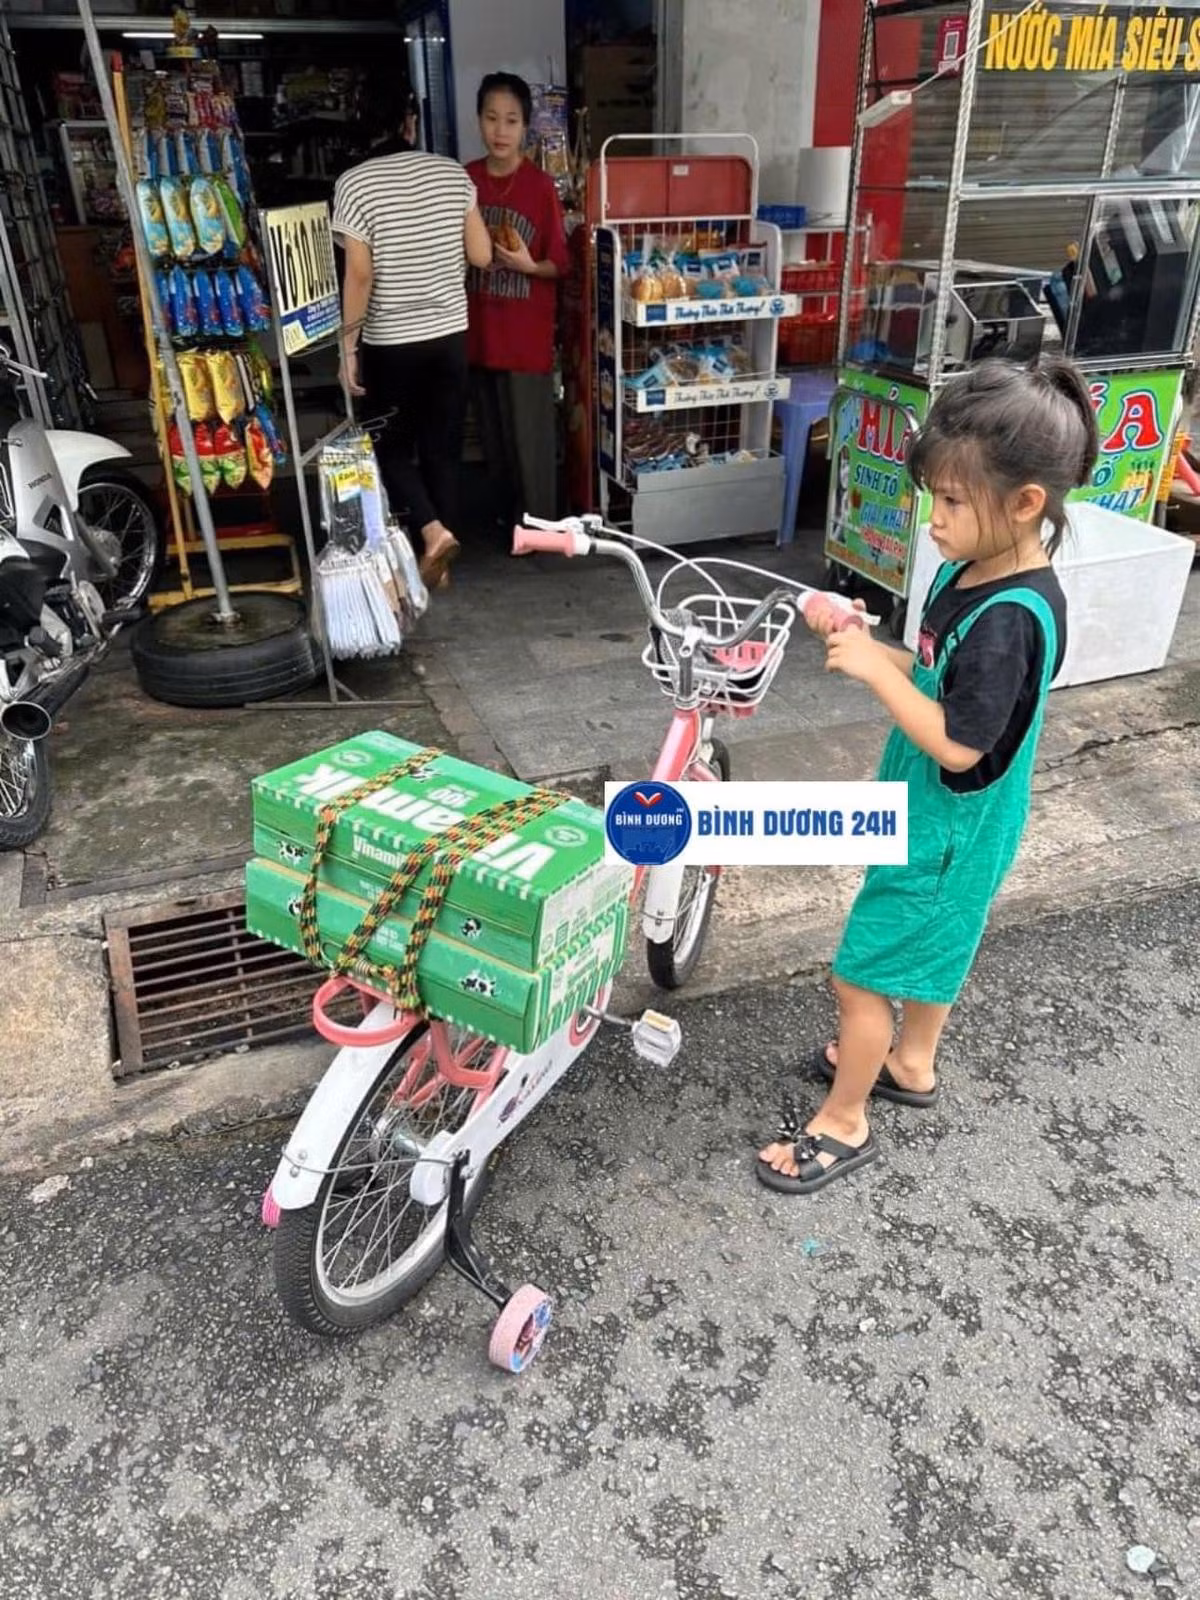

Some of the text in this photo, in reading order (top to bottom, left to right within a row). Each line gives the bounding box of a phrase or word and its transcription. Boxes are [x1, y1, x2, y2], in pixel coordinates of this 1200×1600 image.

[985, 2, 1062, 71] NƯỚC
[1065, 5, 1118, 71] MÍA
[1121, 7, 1184, 72] SIÊU
[854, 463, 881, 491] SINH
[293, 763, 557, 882] Viamlk
